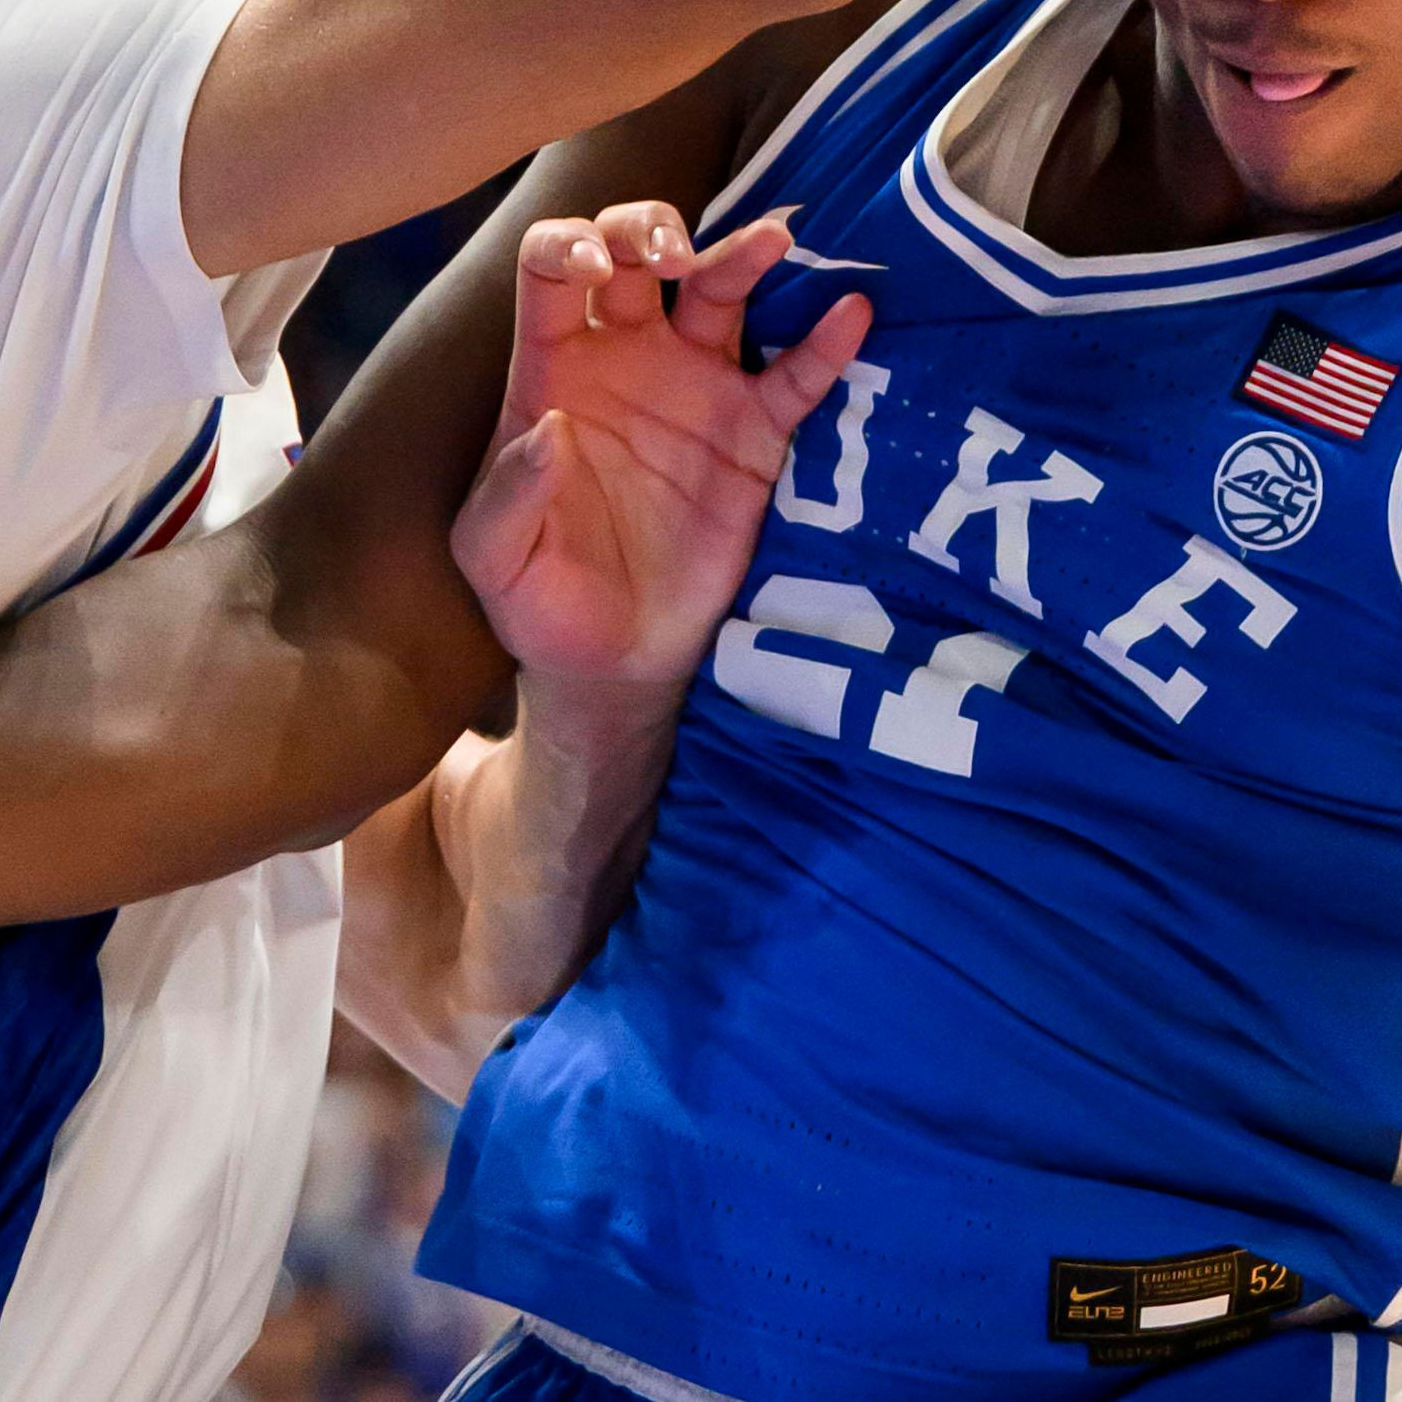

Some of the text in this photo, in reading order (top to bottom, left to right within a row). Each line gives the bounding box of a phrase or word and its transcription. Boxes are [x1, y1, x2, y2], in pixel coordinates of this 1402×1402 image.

[1232, 469, 1316, 519] ACC
[760, 344, 1298, 724] UKE
[1249, 1262, 1288, 1295] 52
